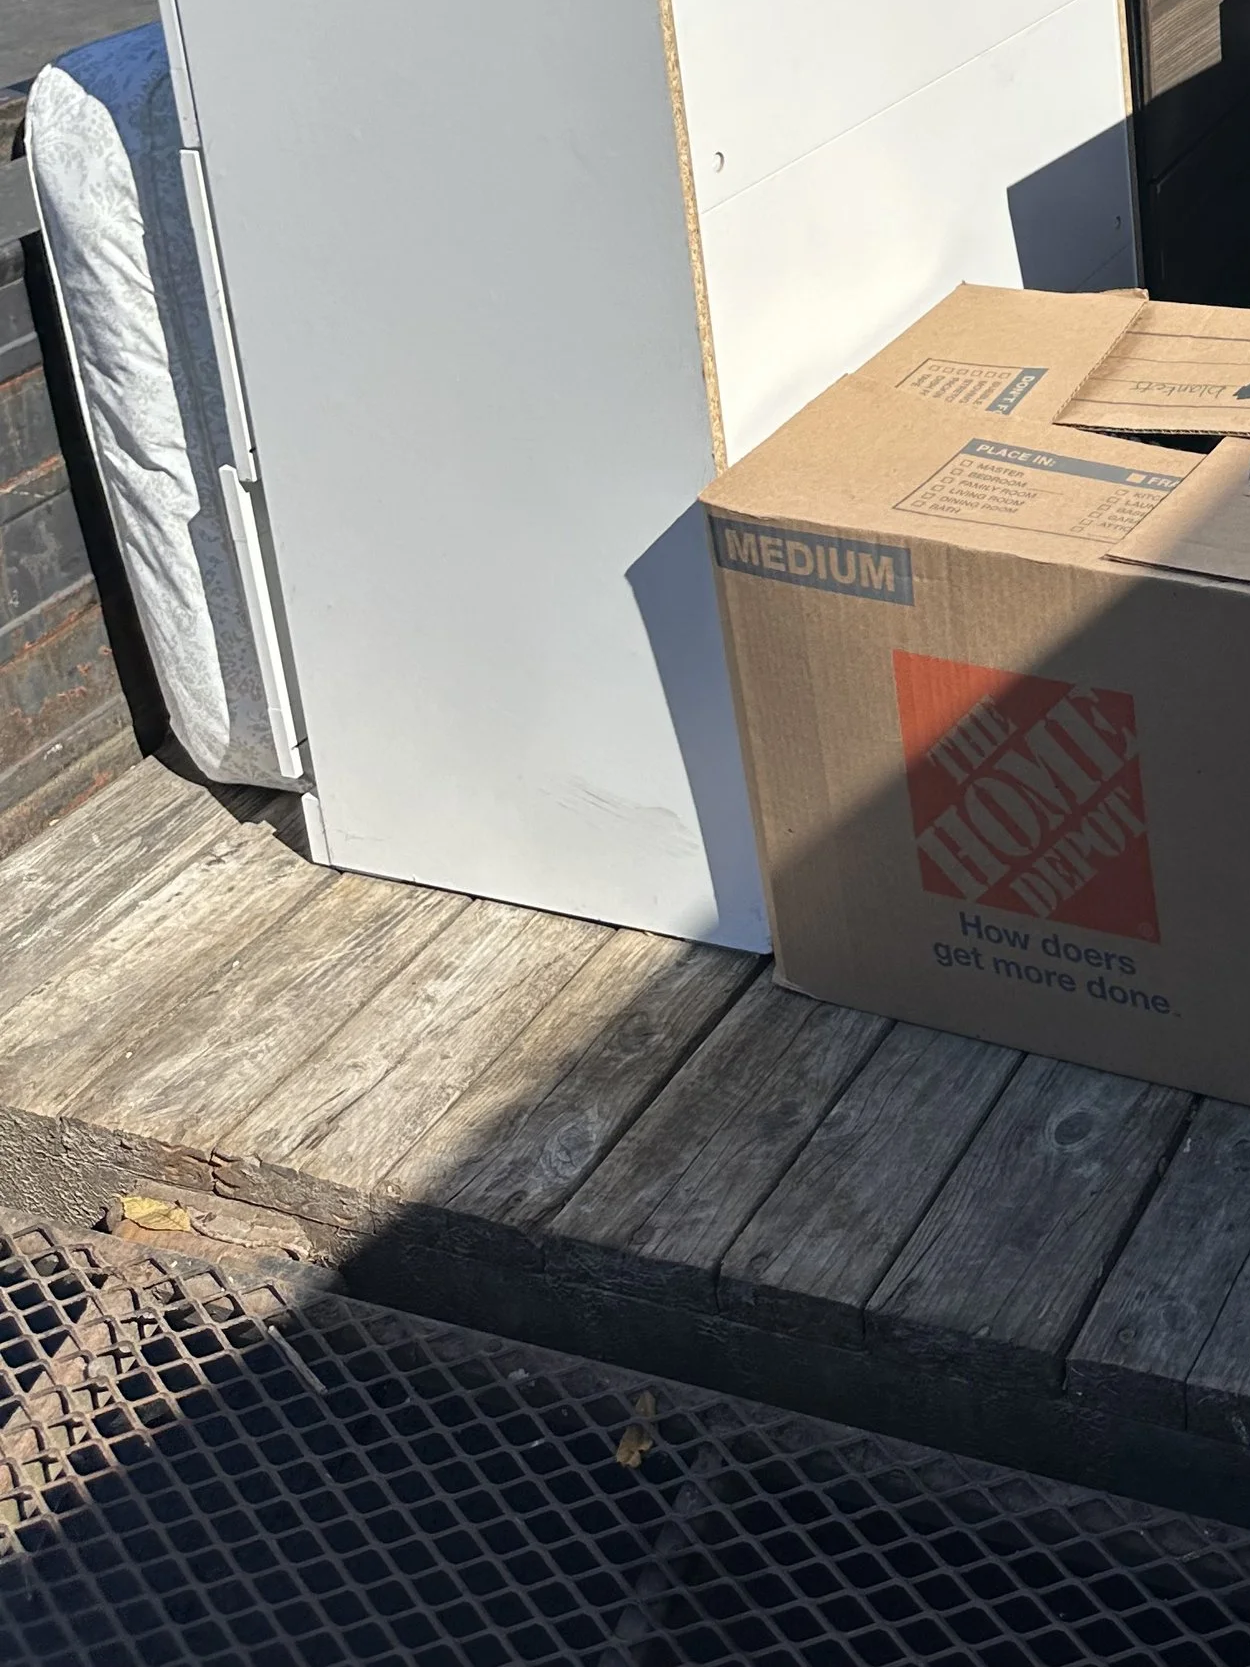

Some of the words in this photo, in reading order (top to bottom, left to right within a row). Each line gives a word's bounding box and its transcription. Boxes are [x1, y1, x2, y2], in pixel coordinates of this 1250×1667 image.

[1130, 380, 1227, 400] blankets
[976, 444, 1032, 461] PLACE
[1032, 454, 1057, 467] IN:
[968, 472, 1028, 488] BEDROOM
[977, 463, 1025, 478] MASTER
[949, 487, 986, 501] LIVING
[988, 495, 1025, 506] ROOM
[959, 480, 1000, 494] FAMILY
[1000, 488, 1037, 499] ROOM
[929, 503, 961, 514] BATH
[940, 495, 980, 508] DINING
[981, 503, 1019, 514] ROOM
[725, 528, 896, 593] MEDIUM
[927, 693, 1020, 785] THE
[916, 685, 1138, 902] HOME
[1009, 784, 1148, 920] DEPOT
[959, 911, 1030, 951] How
[1042, 934, 1137, 975] doers
[933, 941, 985, 971] get
[993, 955, 1077, 993] more
